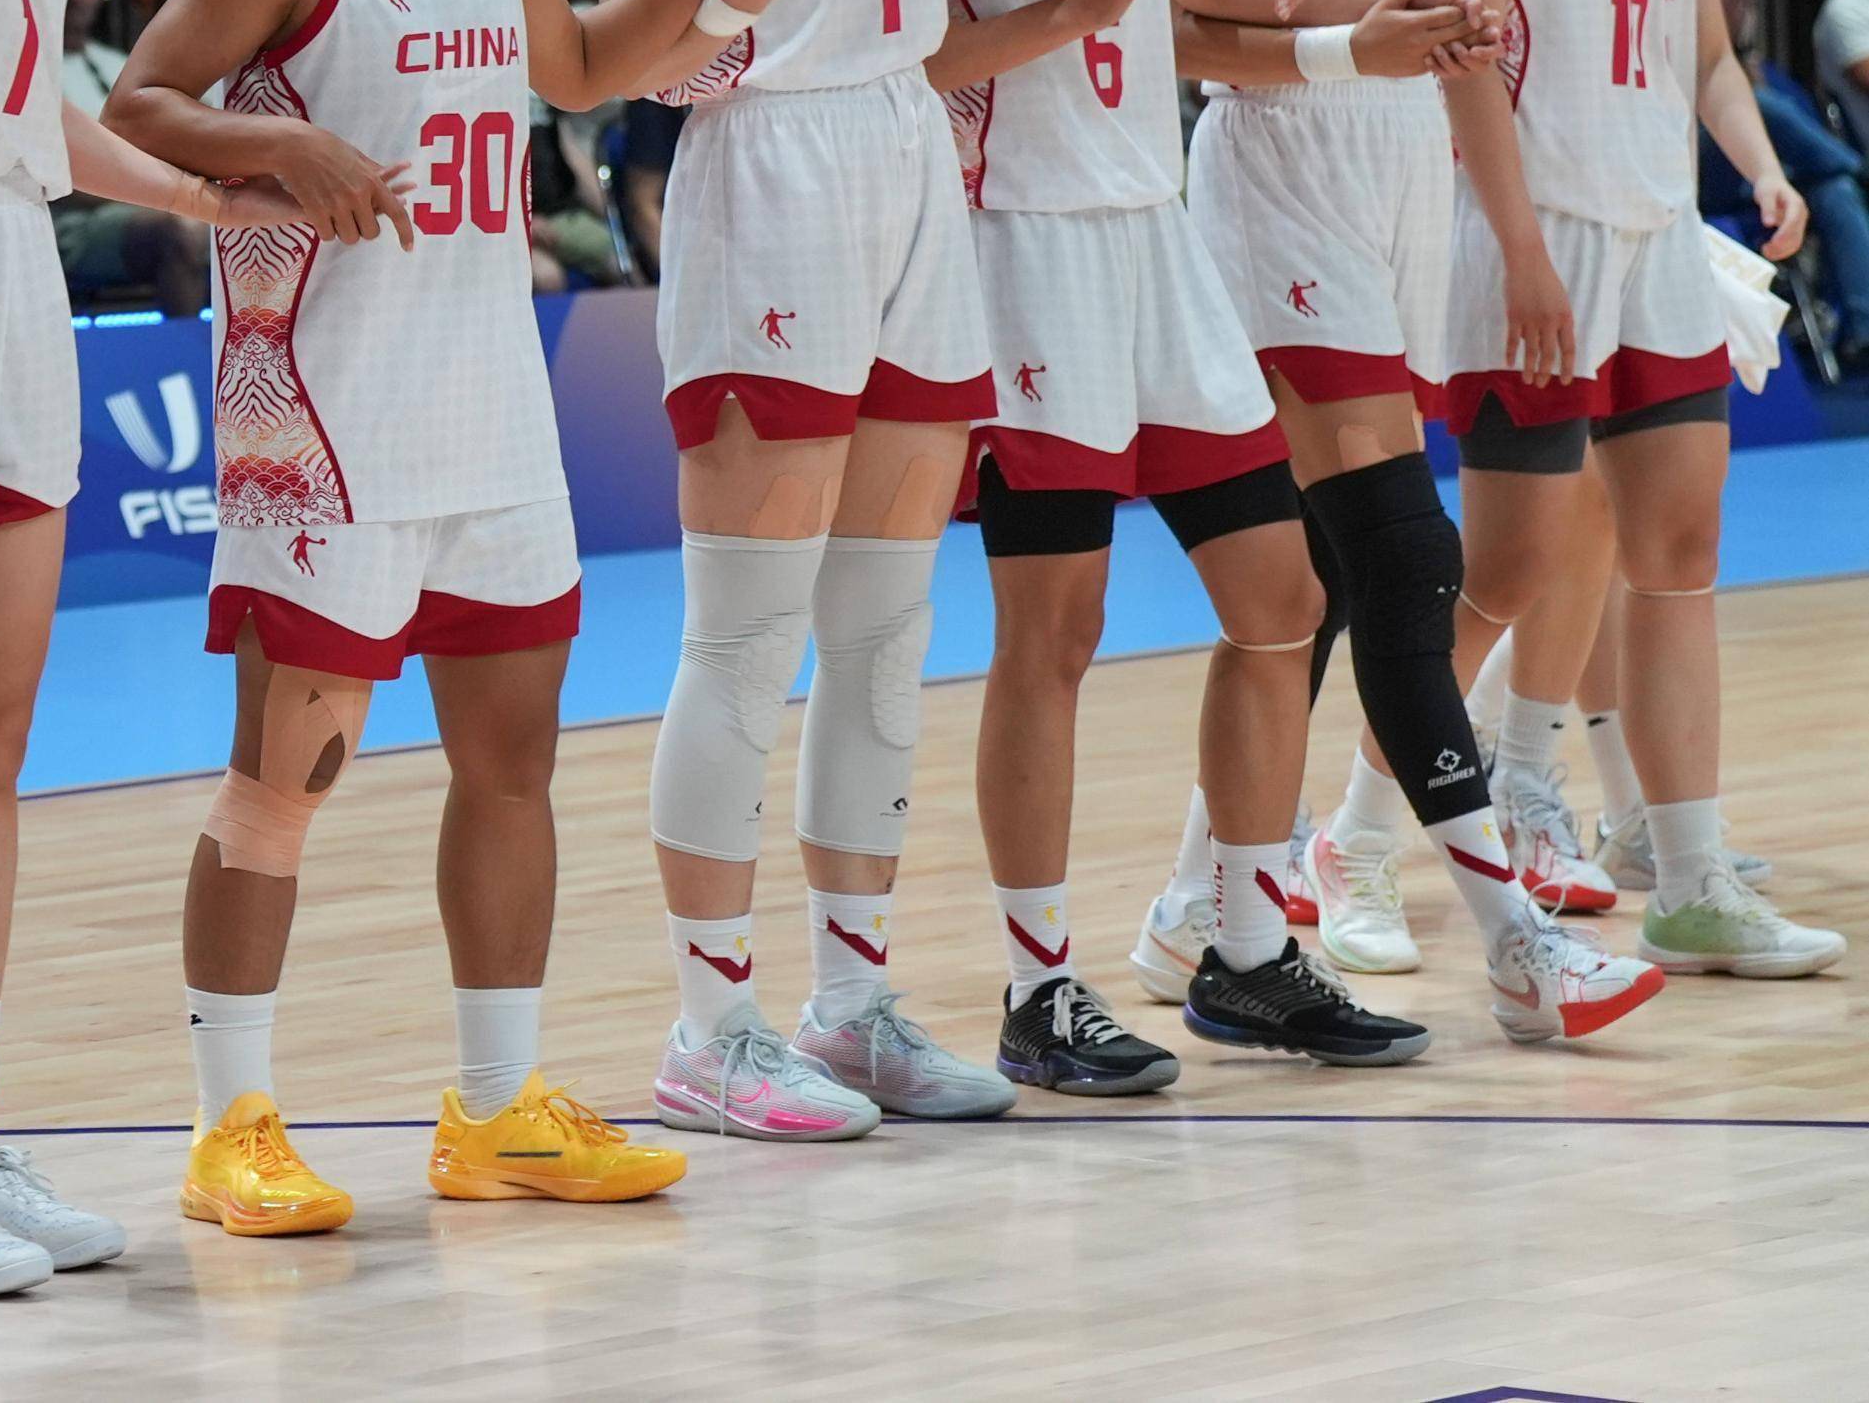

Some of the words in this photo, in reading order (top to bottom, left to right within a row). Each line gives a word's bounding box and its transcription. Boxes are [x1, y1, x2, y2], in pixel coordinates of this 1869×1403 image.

[395, 26, 520, 74] CHINA
[1083, 21, 1123, 109] 6
[413, 111, 514, 235] 30
